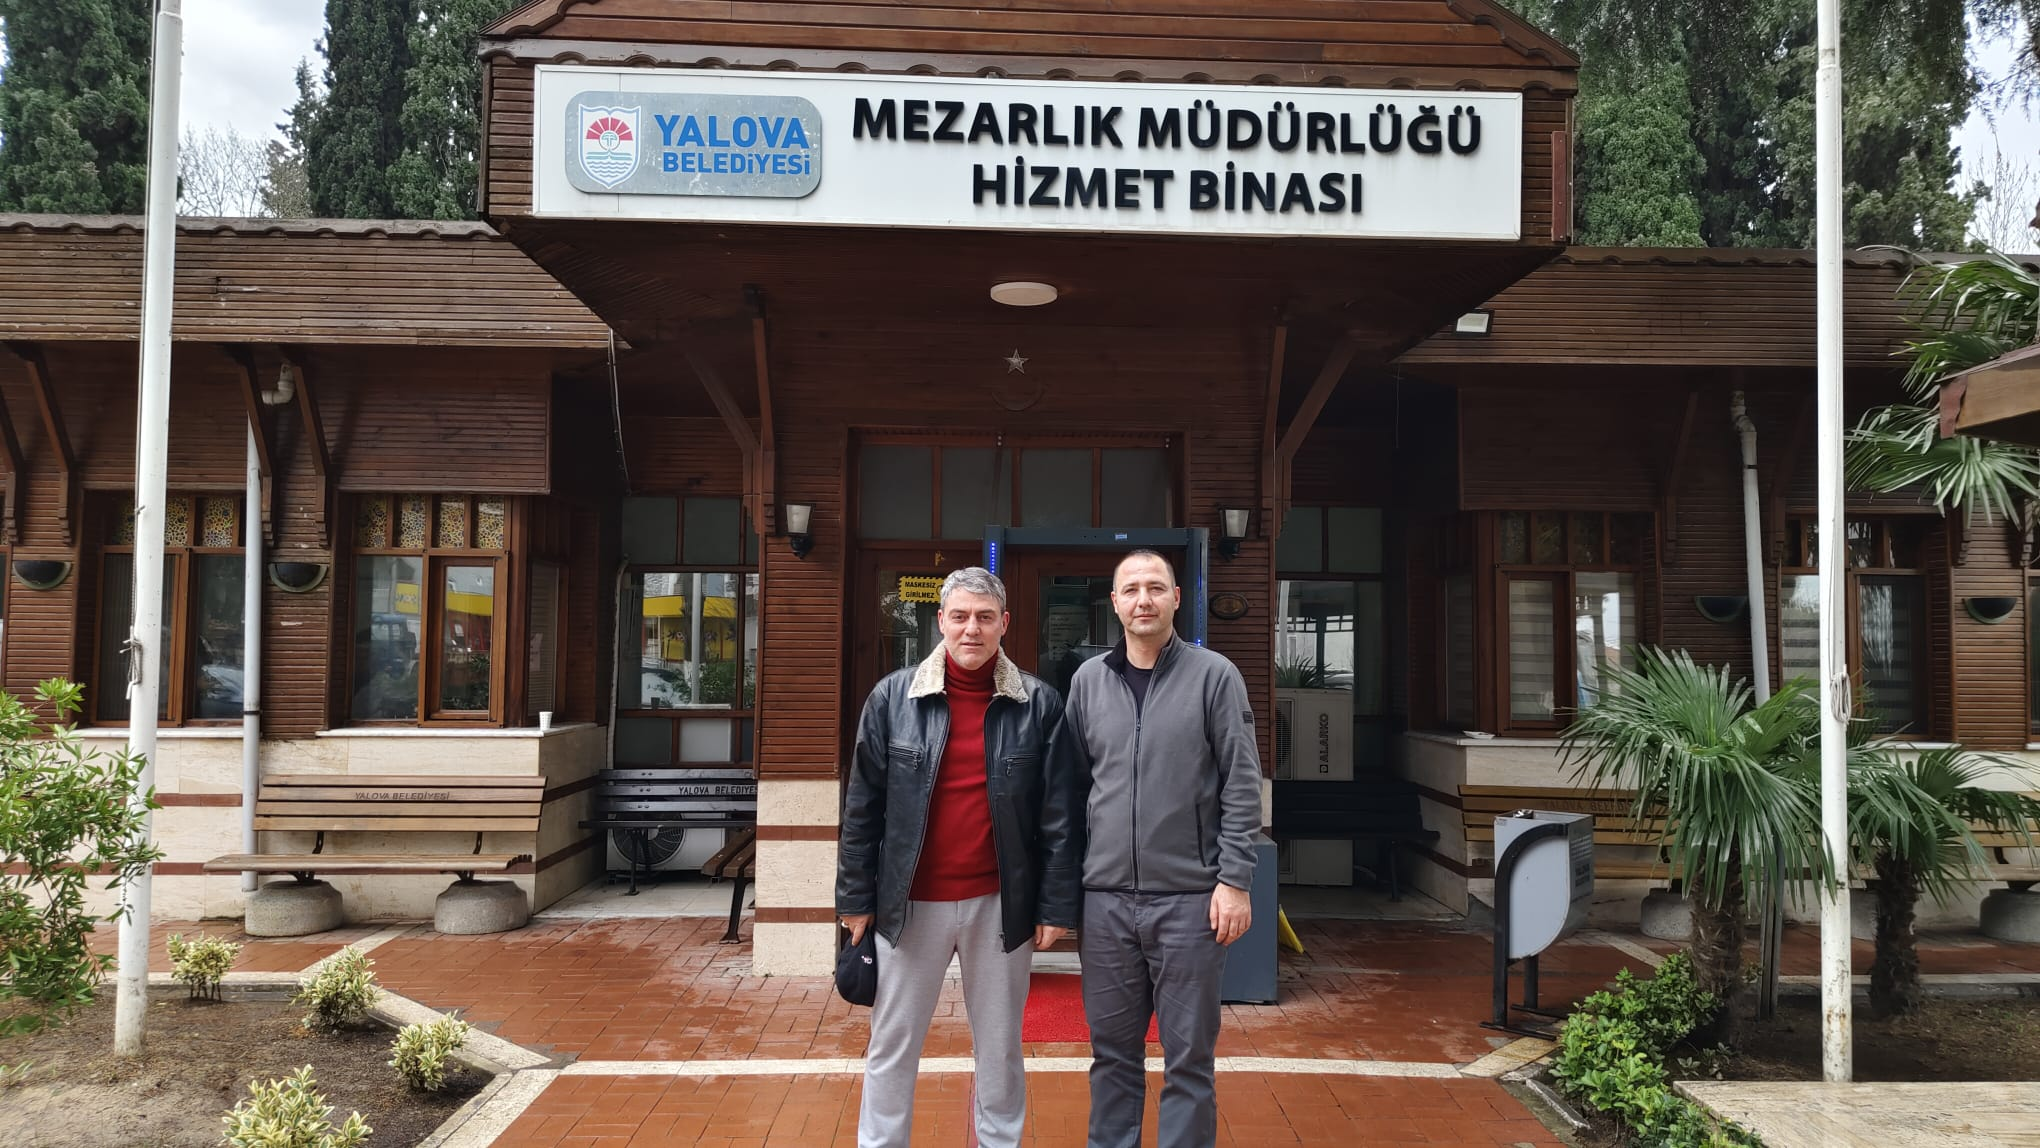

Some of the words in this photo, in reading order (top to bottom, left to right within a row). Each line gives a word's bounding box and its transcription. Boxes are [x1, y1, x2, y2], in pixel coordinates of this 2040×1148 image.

[654, 114, 810, 149] YALOVA
[853, 97, 1124, 148] MEZARLIK
[1137, 98, 1482, 155] MÜDÜRLÜĞÜ
[971, 155, 1174, 210] HİZMET
[1188, 160, 1363, 214] BİNASI
[355, 792, 390, 800] YALOVA
[678, 786, 709, 795] YALOVA
